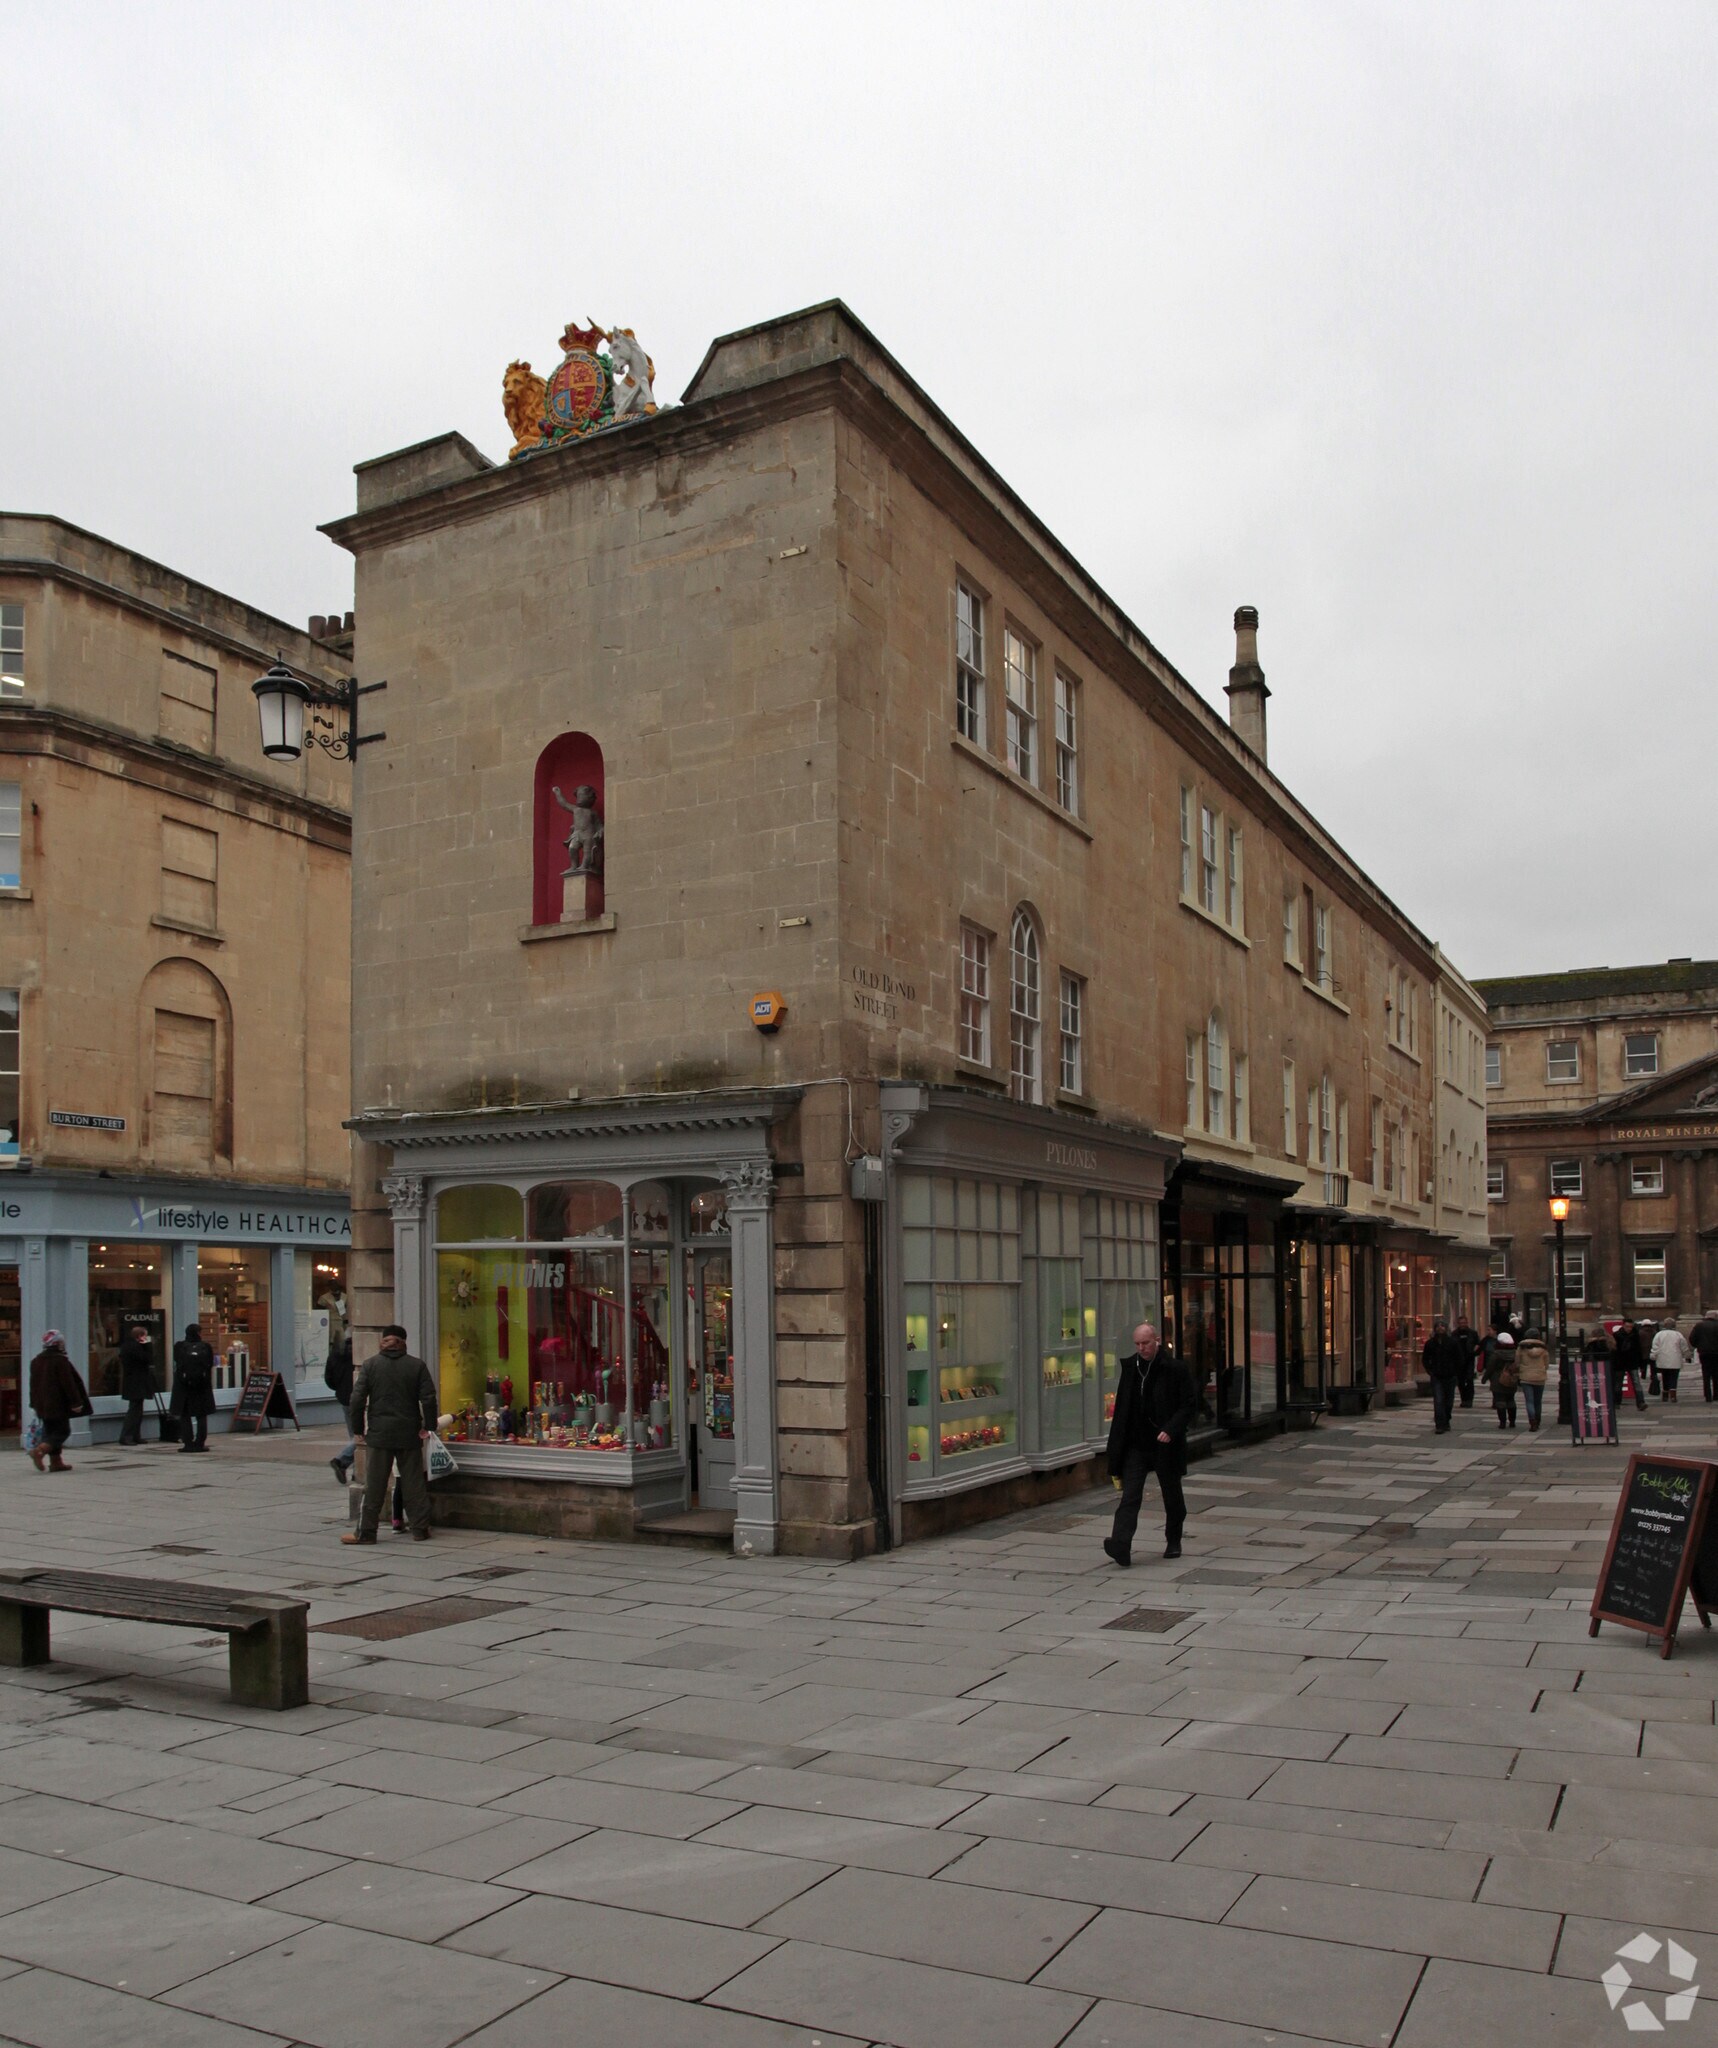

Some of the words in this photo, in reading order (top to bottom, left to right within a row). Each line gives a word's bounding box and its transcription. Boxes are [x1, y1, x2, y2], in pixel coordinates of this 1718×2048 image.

[853, 965, 879, 989] OLD
[883, 974, 915, 1000] BOND
[754, 1003, 771, 1014] ADT
[854, 990, 897, 1020] STREET
[53, 1113, 89, 1125] BURTON
[92, 1118, 123, 1129] STREET
[1618, 1129, 1659, 1139] ROYAL
[1666, 1126, 1718, 1137] MINERA
[1046, 1141, 1097, 1170] PYLONES
[158, 1207, 229, 1233] lifestyle
[240, 1212, 352, 1235] HEALTHCA
[493, 1262, 566, 1288] PYLONES
[1630, 1507, 1685, 1522] www.bobbymak.com
[1637, 1521, 1652, 1531] 01225
